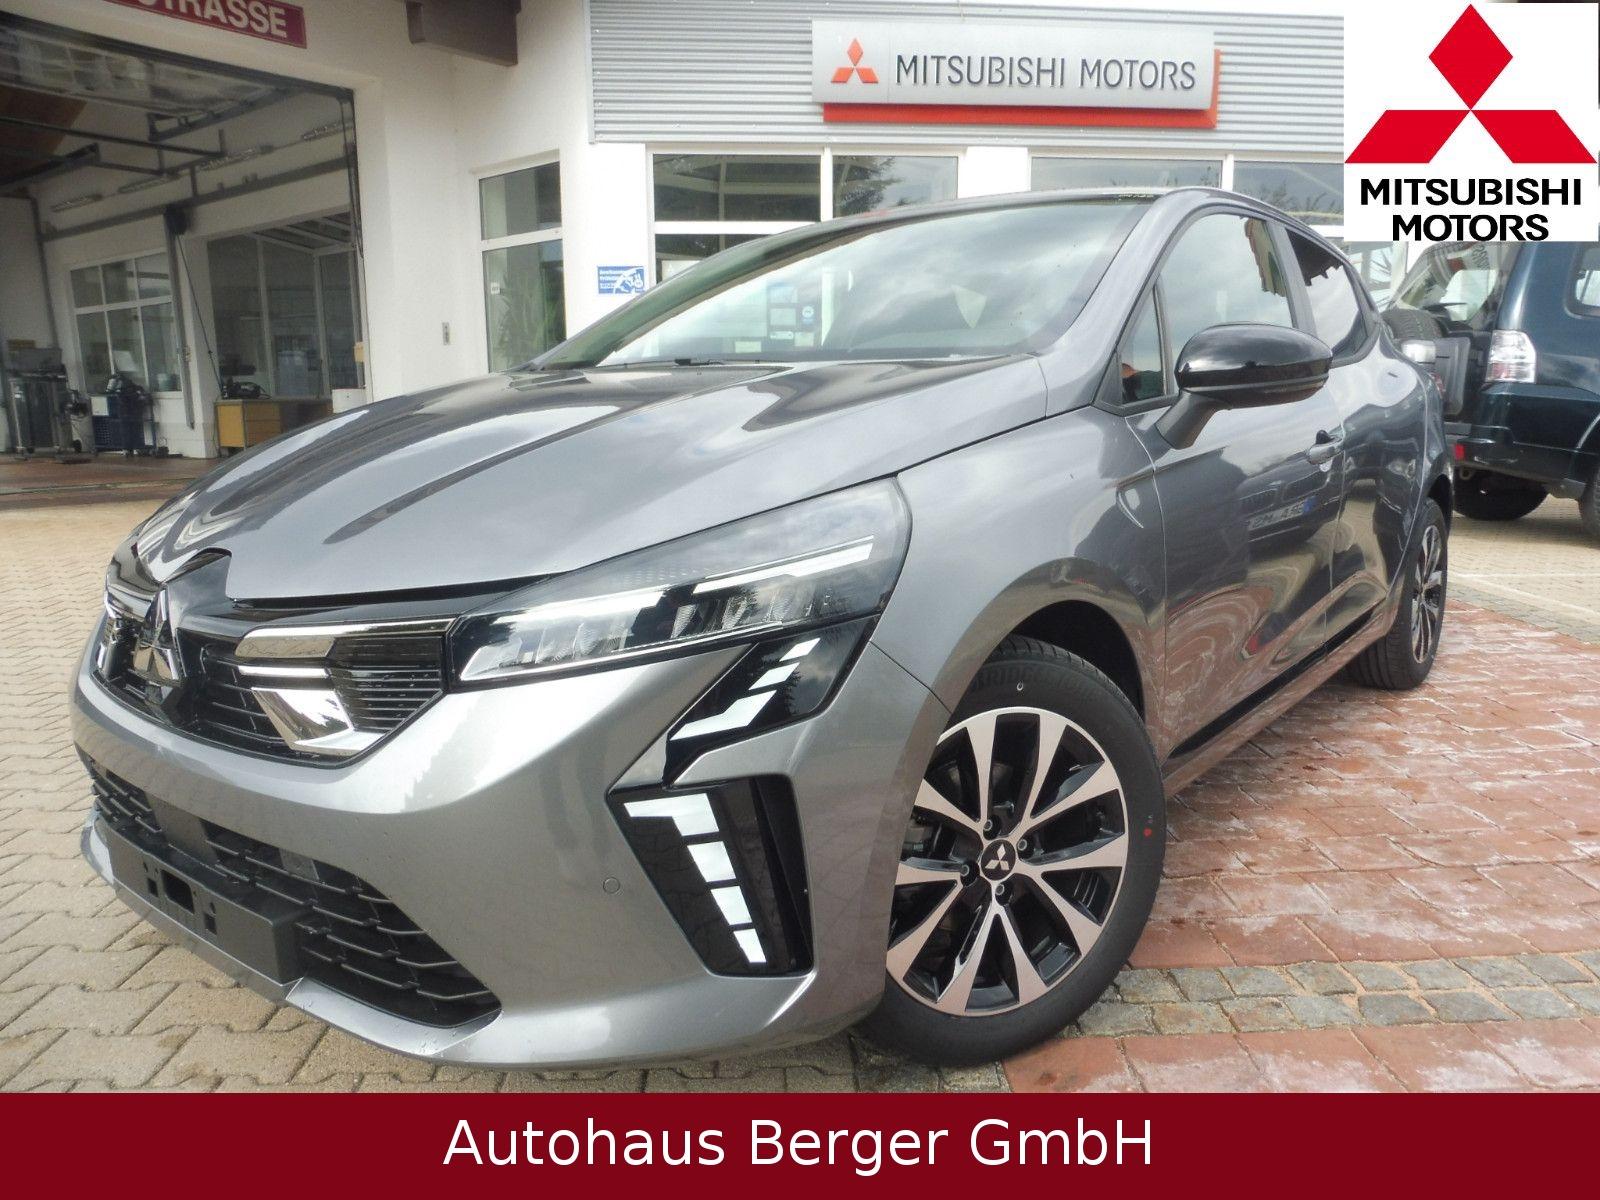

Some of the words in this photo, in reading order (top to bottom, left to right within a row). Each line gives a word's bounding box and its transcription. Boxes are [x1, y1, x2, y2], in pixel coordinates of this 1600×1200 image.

[138, 0, 287, 38] RASSE
[895, 54, 1065, 88] MITSUBISHI
[1079, 58, 1196, 91] MOTORS
